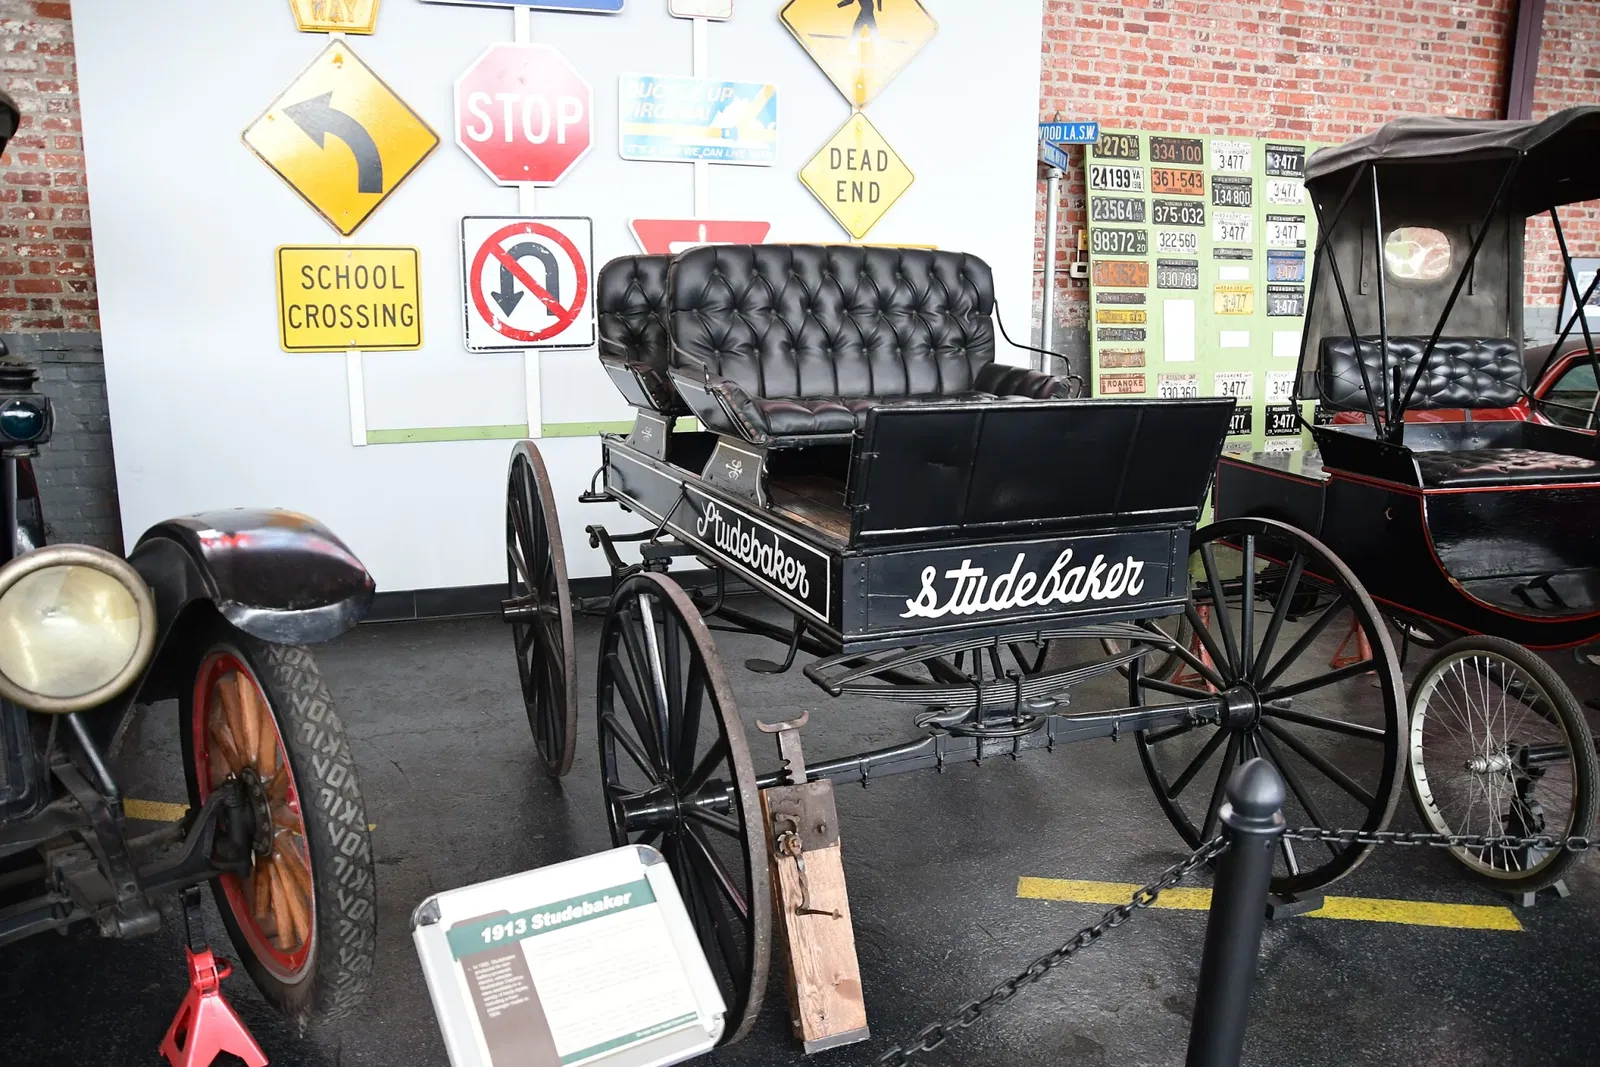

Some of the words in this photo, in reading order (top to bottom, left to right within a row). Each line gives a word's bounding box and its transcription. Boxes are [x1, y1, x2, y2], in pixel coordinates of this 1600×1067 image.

[708, 87, 735, 103] UP
[466, 91, 584, 145] STOP
[684, 146, 701, 156] WE
[703, 147, 724, 158] CAN
[1129, 138, 1138, 148] VA
[830, 147, 888, 172] DEAD
[1092, 167, 1131, 188] 24199
[1132, 169, 1141, 180] VA
[837, 180, 880, 204] END
[1093, 199, 1133, 220] 23564
[1133, 201, 1143, 211] VA
[1093, 231, 1135, 253] 98372
[1136, 233, 1146, 241] VA
[1136, 244, 1146, 253] 20
[301, 264, 405, 290] SCHOOL
[288, 303, 414, 329] CROSSING
[1107, 379, 1144, 388] ROANOKE
[697, 501, 810, 599] Studebaker
[899, 548, 1145, 618] Studebaker
[481, 918, 527, 944] 1913
[531, 892, 632, 930] Studebaker
